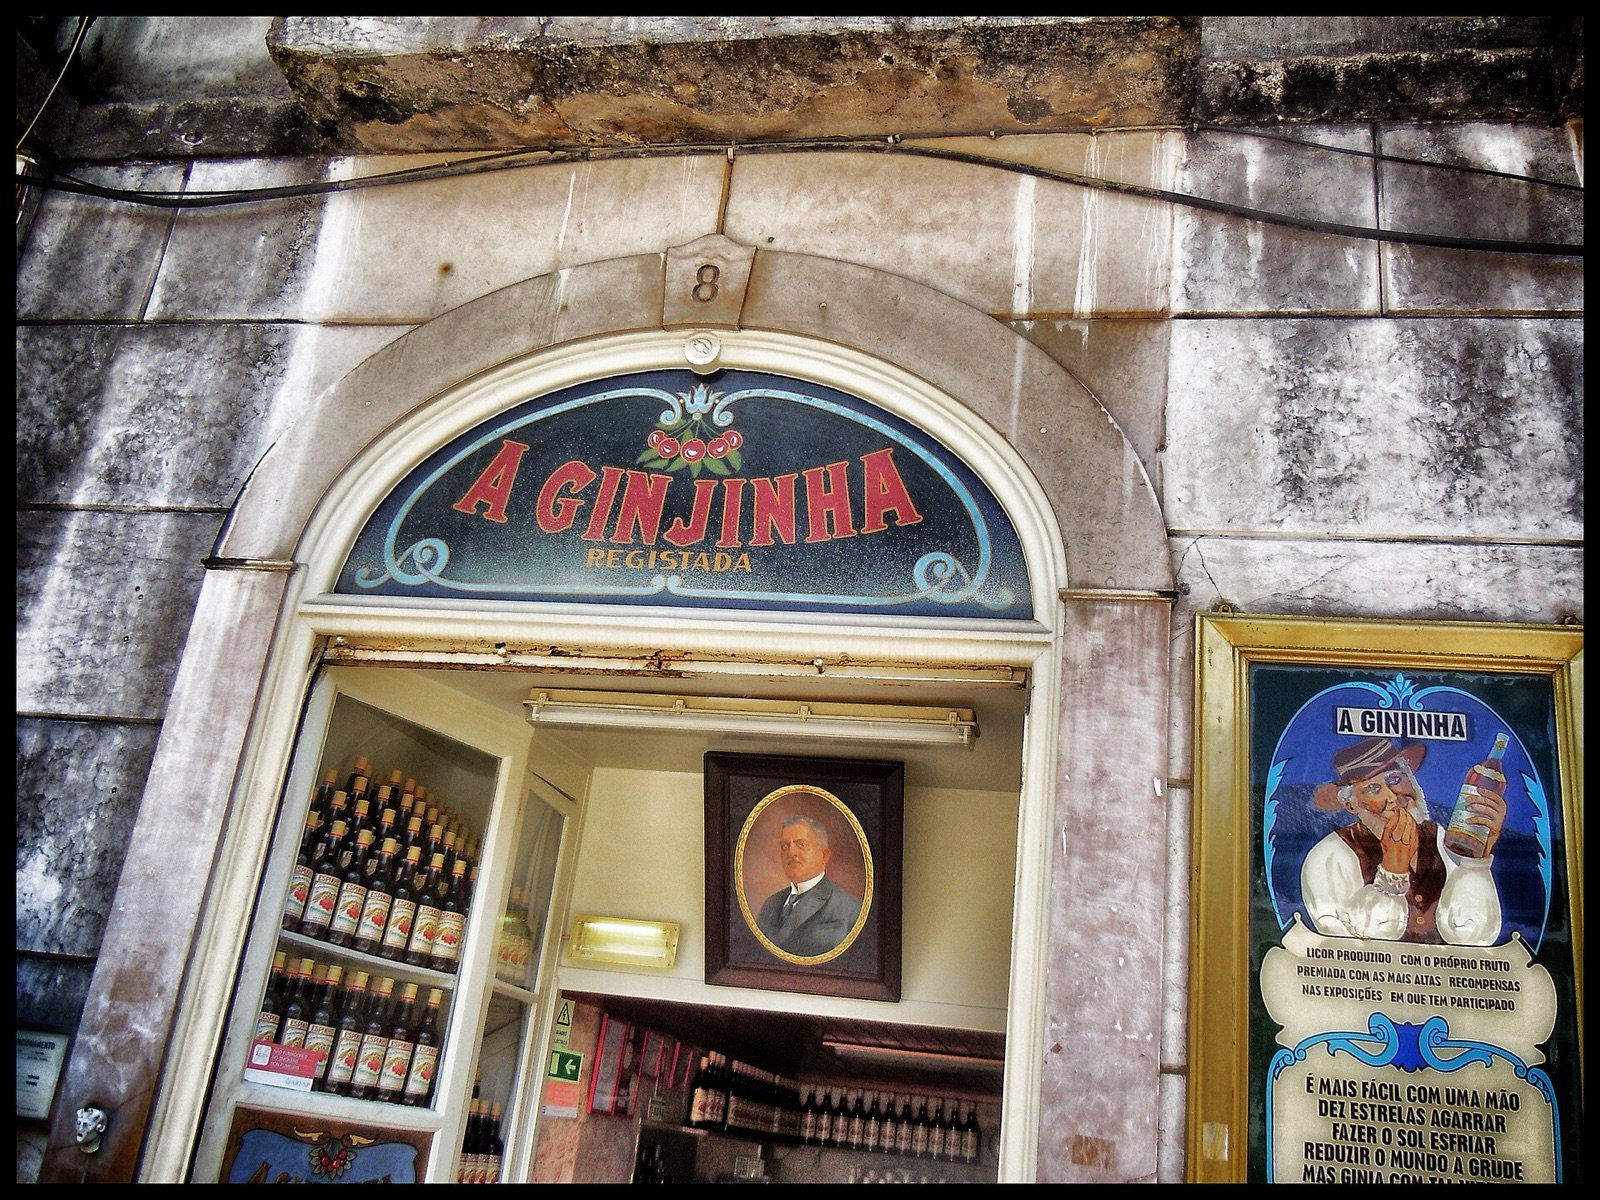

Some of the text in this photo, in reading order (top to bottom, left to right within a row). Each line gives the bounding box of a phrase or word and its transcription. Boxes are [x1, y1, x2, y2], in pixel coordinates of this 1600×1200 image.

[692, 264, 720, 302] 8
[453, 439, 923, 549] A GINJINHA
[586, 548, 753, 573] REGISTADA
[1339, 709, 1465, 740] A GINJINHA
[1307, 947, 1510, 972] LICOR PRODUZIDO COM O PRÓPRIO FRUTO
[1297, 965, 1521, 992] PREMIADA COM AS MAIS ALTAS RECOMPENSAS
[1302, 984, 1321, 996] NAS
[1323, 985, 1383, 1002] EXPOSIÇÕES
[1390, 991, 1404, 1003] EM
[1428, 995, 1448, 1007] TEM
[1450, 997, 1515, 1011] PARTICIPADO
[1306, 1073, 1520, 1112] É MAIS FÁCIL COM UMA MÃO
[1318, 1099, 1506, 1134] DEZ ESTRELAS AGARRAR
[1332, 1122, 1497, 1155] FAZER O SOL ESFRIAR
[1302, 1164, 1336, 1184] MAS
[1304, 1141, 1524, 1181] REDUZIR O MUNDO A GRUDE
